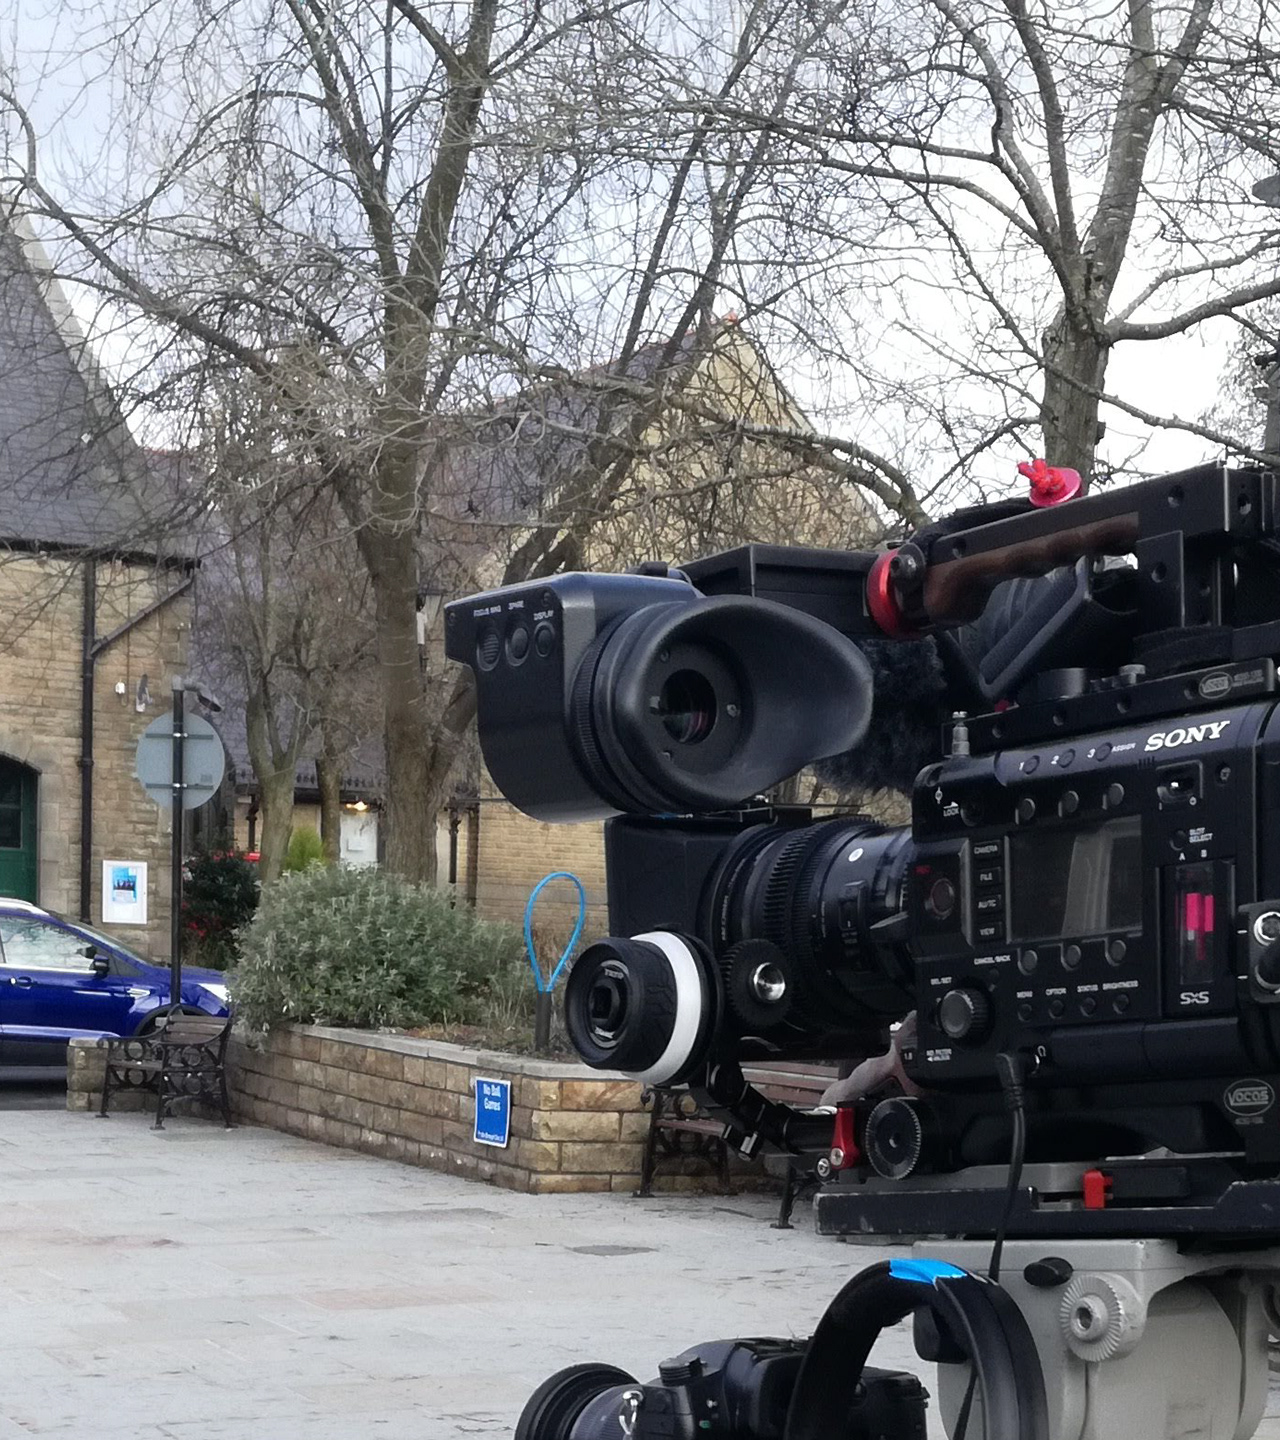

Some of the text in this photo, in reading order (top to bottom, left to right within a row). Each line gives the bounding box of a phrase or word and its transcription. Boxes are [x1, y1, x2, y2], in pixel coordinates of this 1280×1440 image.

[1144, 720, 1231, 752] SONY
[1051, 755, 1059, 764] 2
[1087, 749, 1096, 758] 3
[943, 808, 959, 817] LOCK
[973, 845, 998, 855] CAMERA
[980, 872, 992, 881] FILE
[980, 927, 995, 936] VIEW
